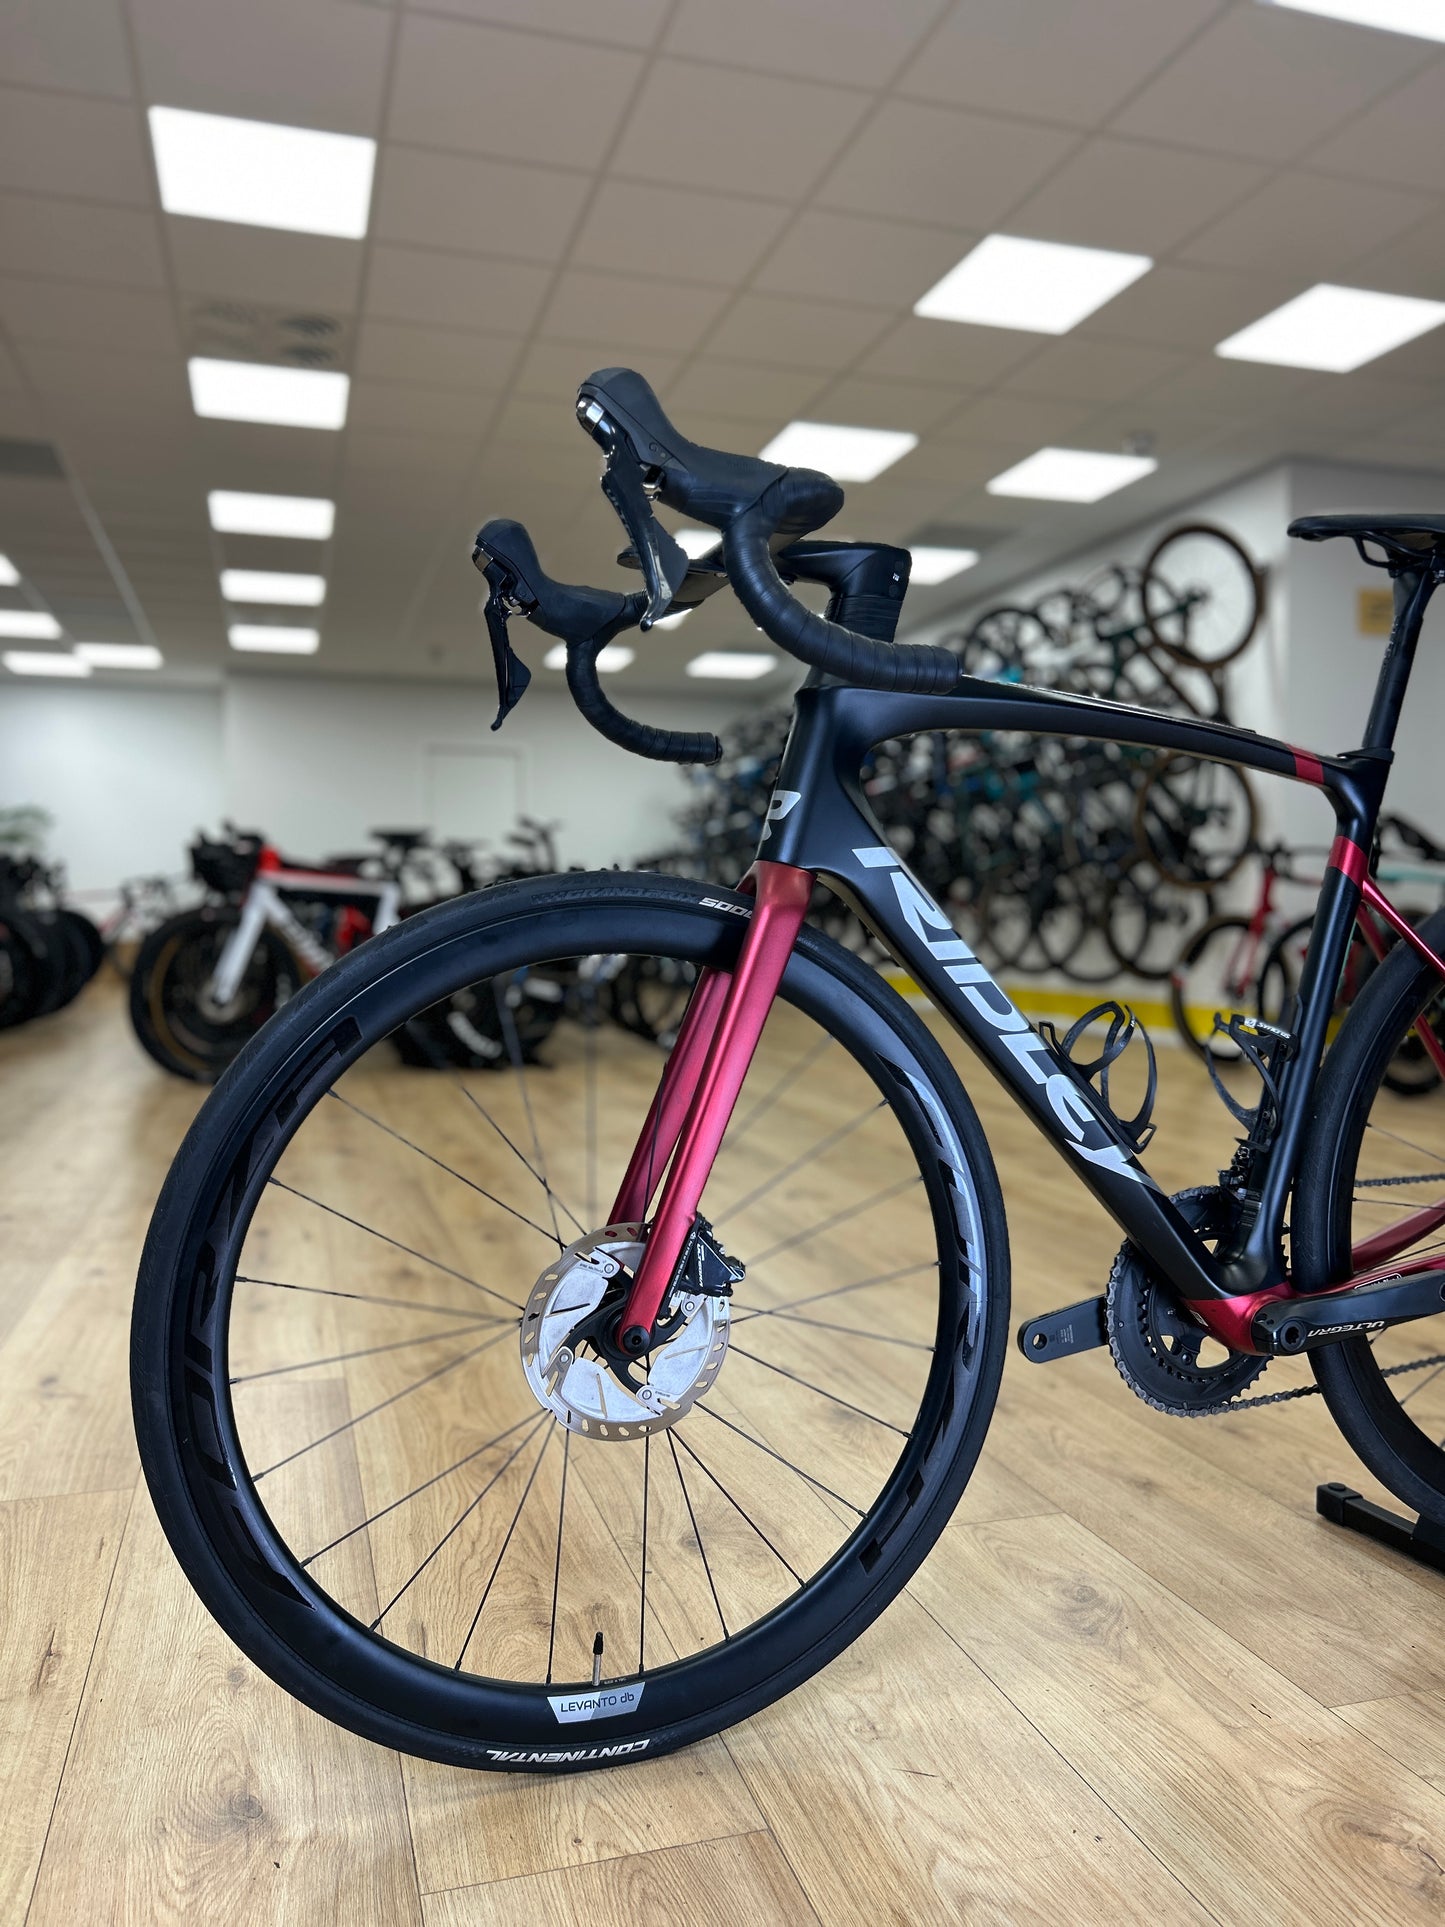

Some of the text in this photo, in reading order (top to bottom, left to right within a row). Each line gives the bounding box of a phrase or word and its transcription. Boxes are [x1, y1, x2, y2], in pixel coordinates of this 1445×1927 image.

[852, 846, 1166, 1198] RIDLEY
[1307, 1320, 1385, 1337] ULTEGRA
[560, 1692, 635, 1713] LEVANTO db
[486, 1738, 650, 1763] CONTINENTAL
